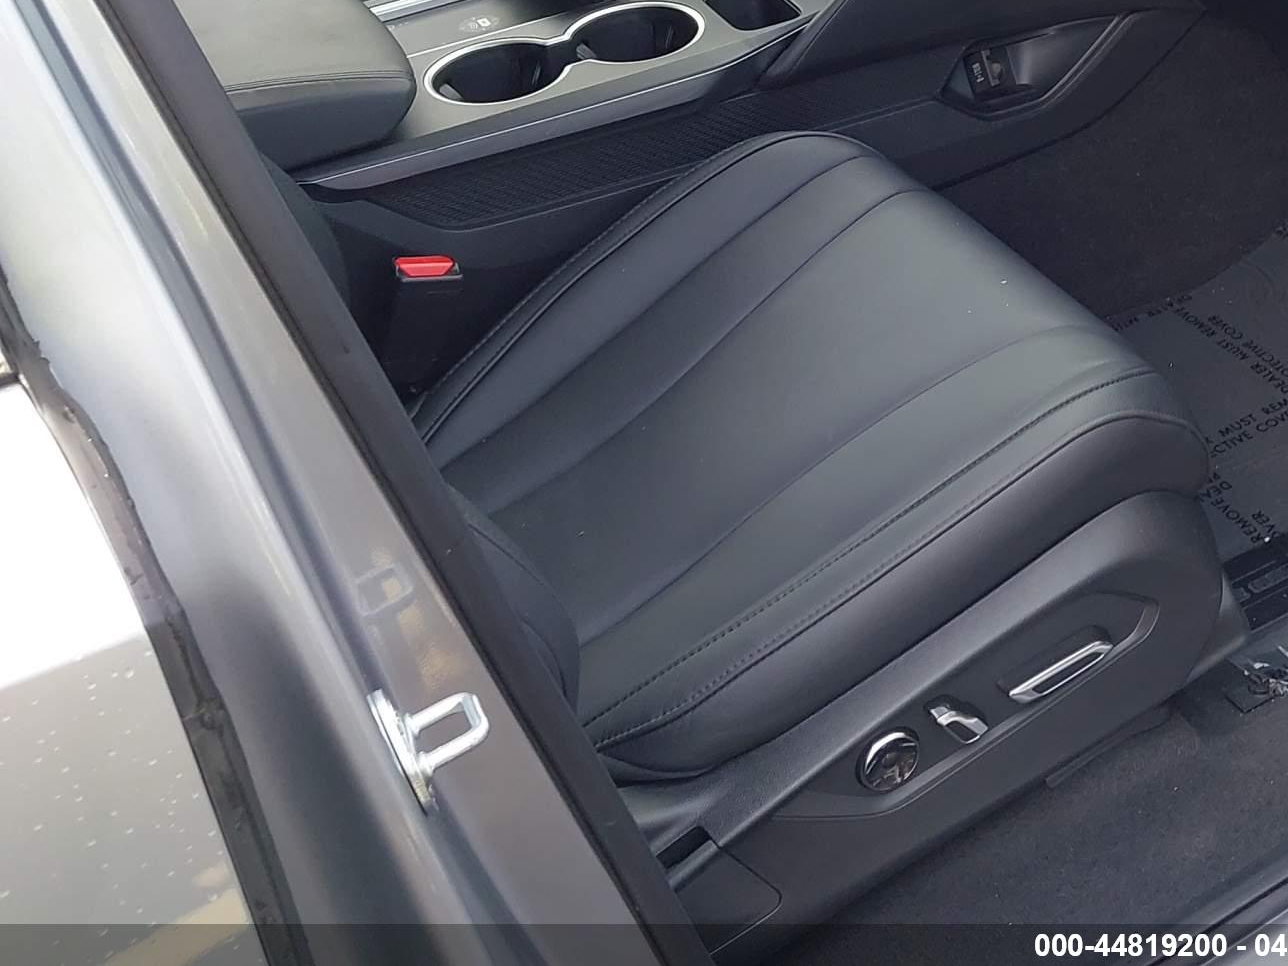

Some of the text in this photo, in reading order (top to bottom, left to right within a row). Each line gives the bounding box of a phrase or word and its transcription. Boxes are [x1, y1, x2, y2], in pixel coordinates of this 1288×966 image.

[1207, 313, 1243, 340] COVER
[1217, 338, 1251, 361] MUST
[1218, 413, 1258, 438] MUST
[1211, 497, 1263, 544] REMOVE
